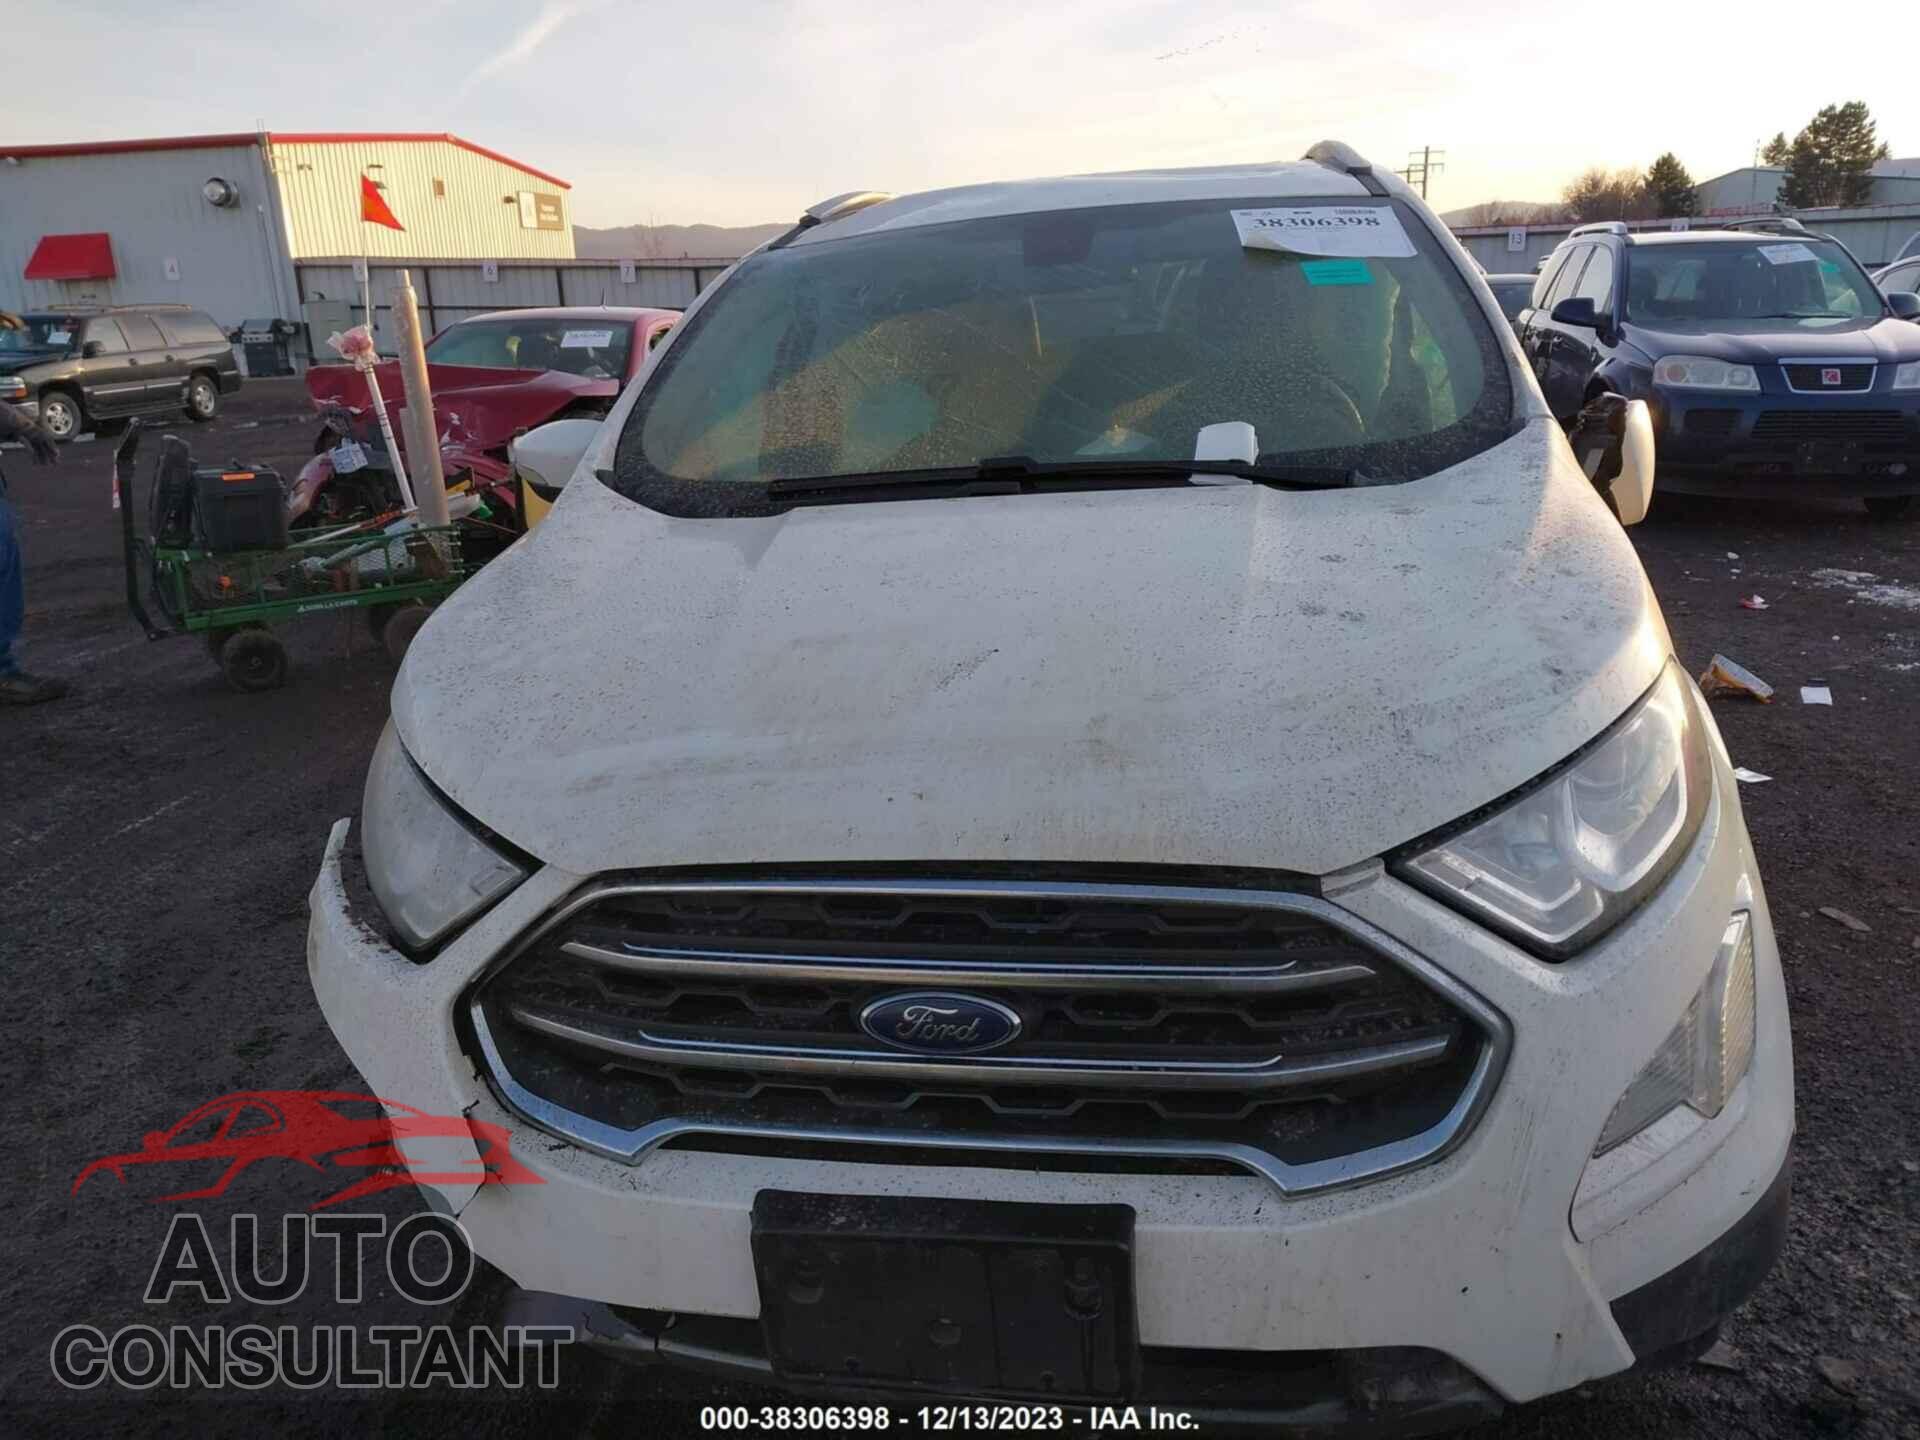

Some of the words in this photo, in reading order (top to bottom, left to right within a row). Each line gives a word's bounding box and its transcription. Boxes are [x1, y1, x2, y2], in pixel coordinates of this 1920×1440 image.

[1253, 217, 1381, 229] 38306398
[1511, 232, 1522, 245] 13
[896, 1005, 982, 1041] Ford
